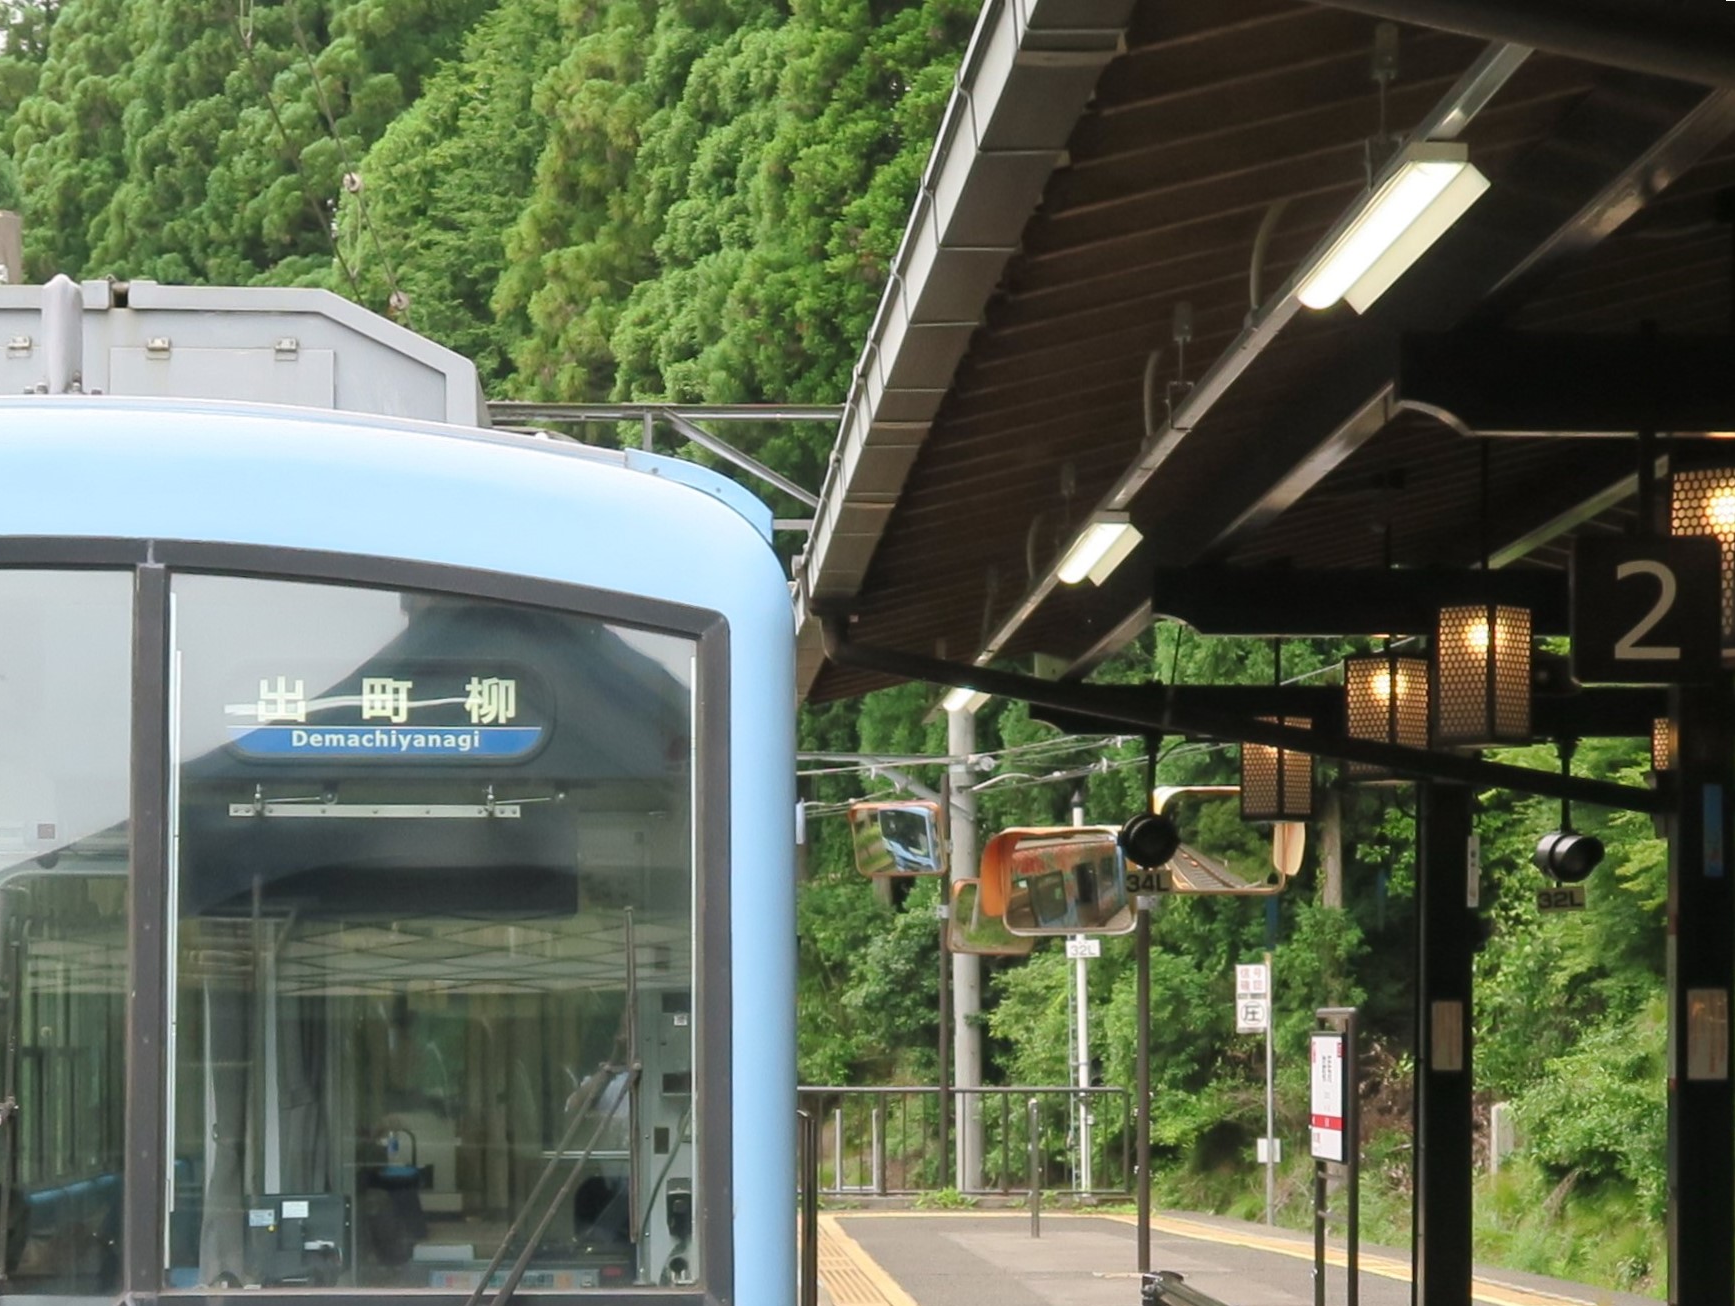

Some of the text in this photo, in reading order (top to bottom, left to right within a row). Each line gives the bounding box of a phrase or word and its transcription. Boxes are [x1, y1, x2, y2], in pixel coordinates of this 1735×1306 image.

[1613, 559, 1681, 660] 2
[257, 676, 517, 724] 出町柳
[291, 729, 481, 752] Demachiyanagi
[1126, 873, 1169, 892] 34L
[1538, 891, 1585, 909] 32L
[1069, 944, 1097, 956] 32L
